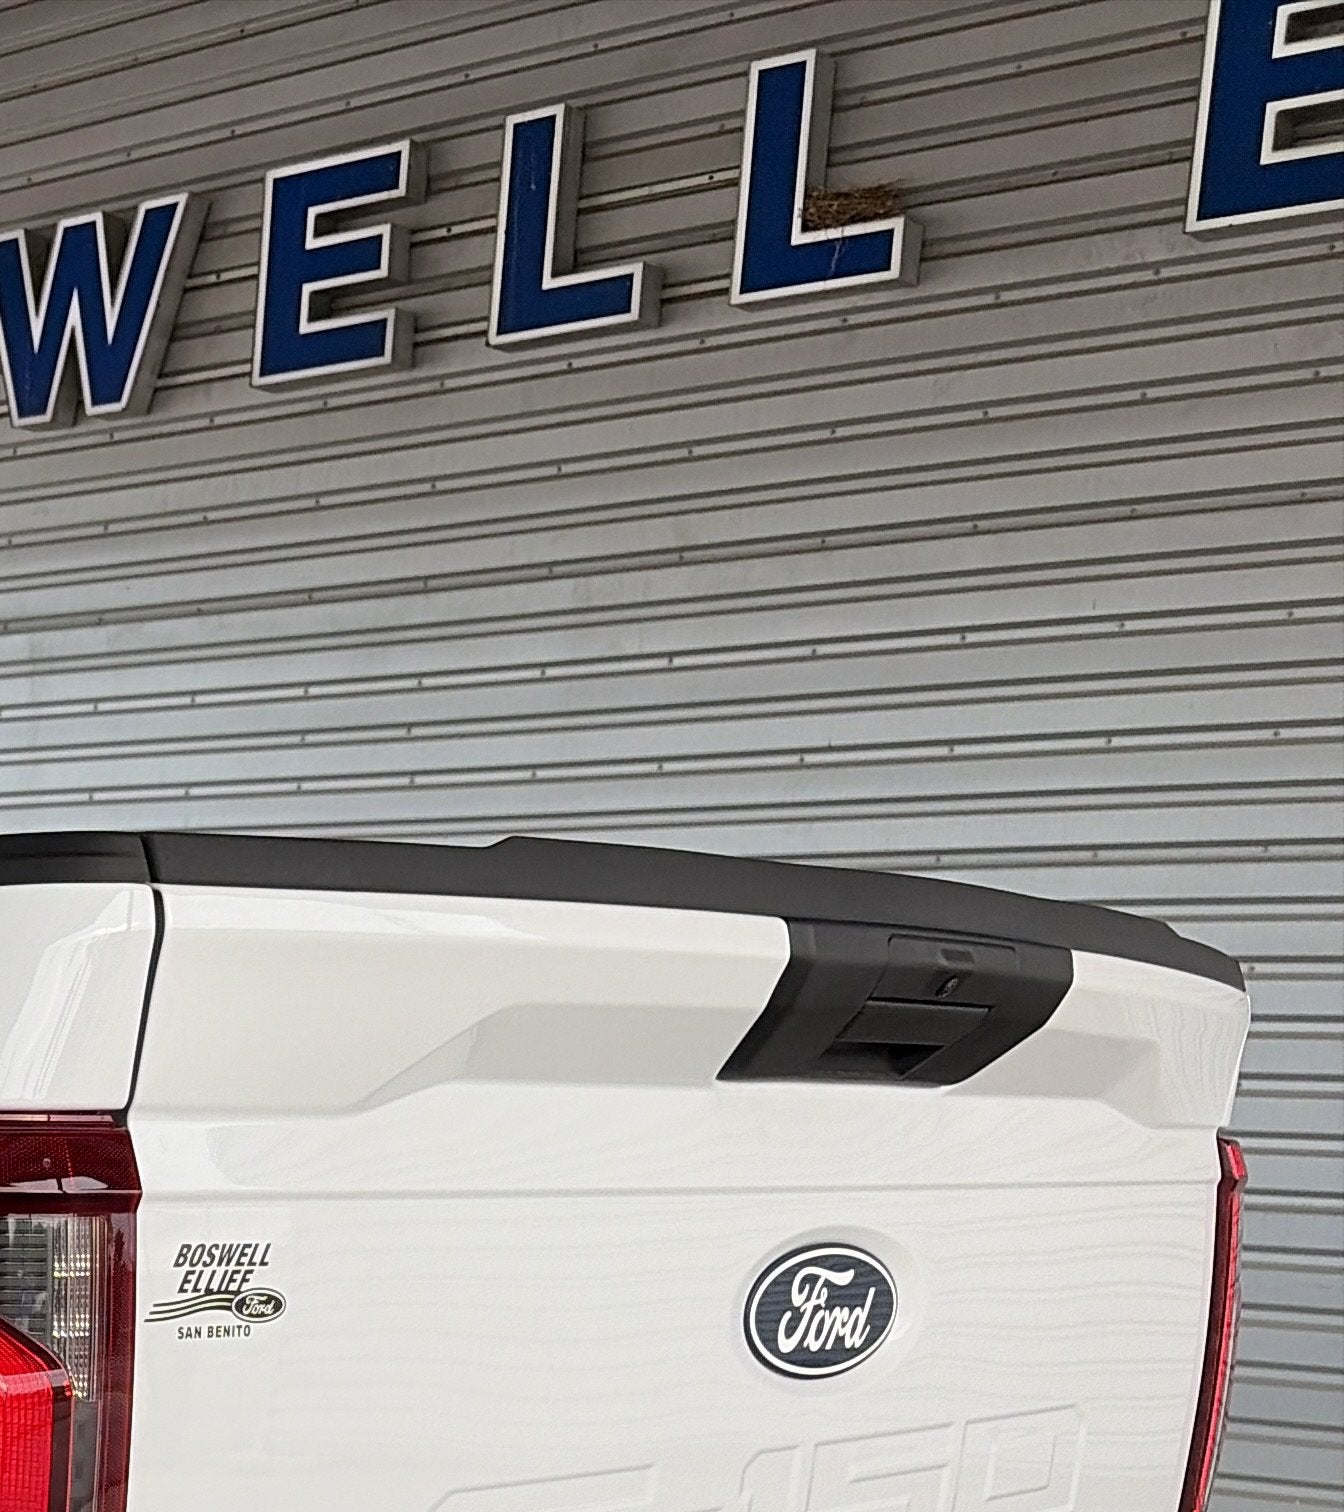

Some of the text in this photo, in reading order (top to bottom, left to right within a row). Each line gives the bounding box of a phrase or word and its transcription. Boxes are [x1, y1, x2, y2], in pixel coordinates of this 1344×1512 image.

[173, 1243, 272, 1268] BOSWELL
[177, 1268, 255, 1294] ELLIFF
[242, 1294, 276, 1316] Ford
[777, 1265, 876, 1354] Ford
[177, 1324, 252, 1340] SAN BENITO
